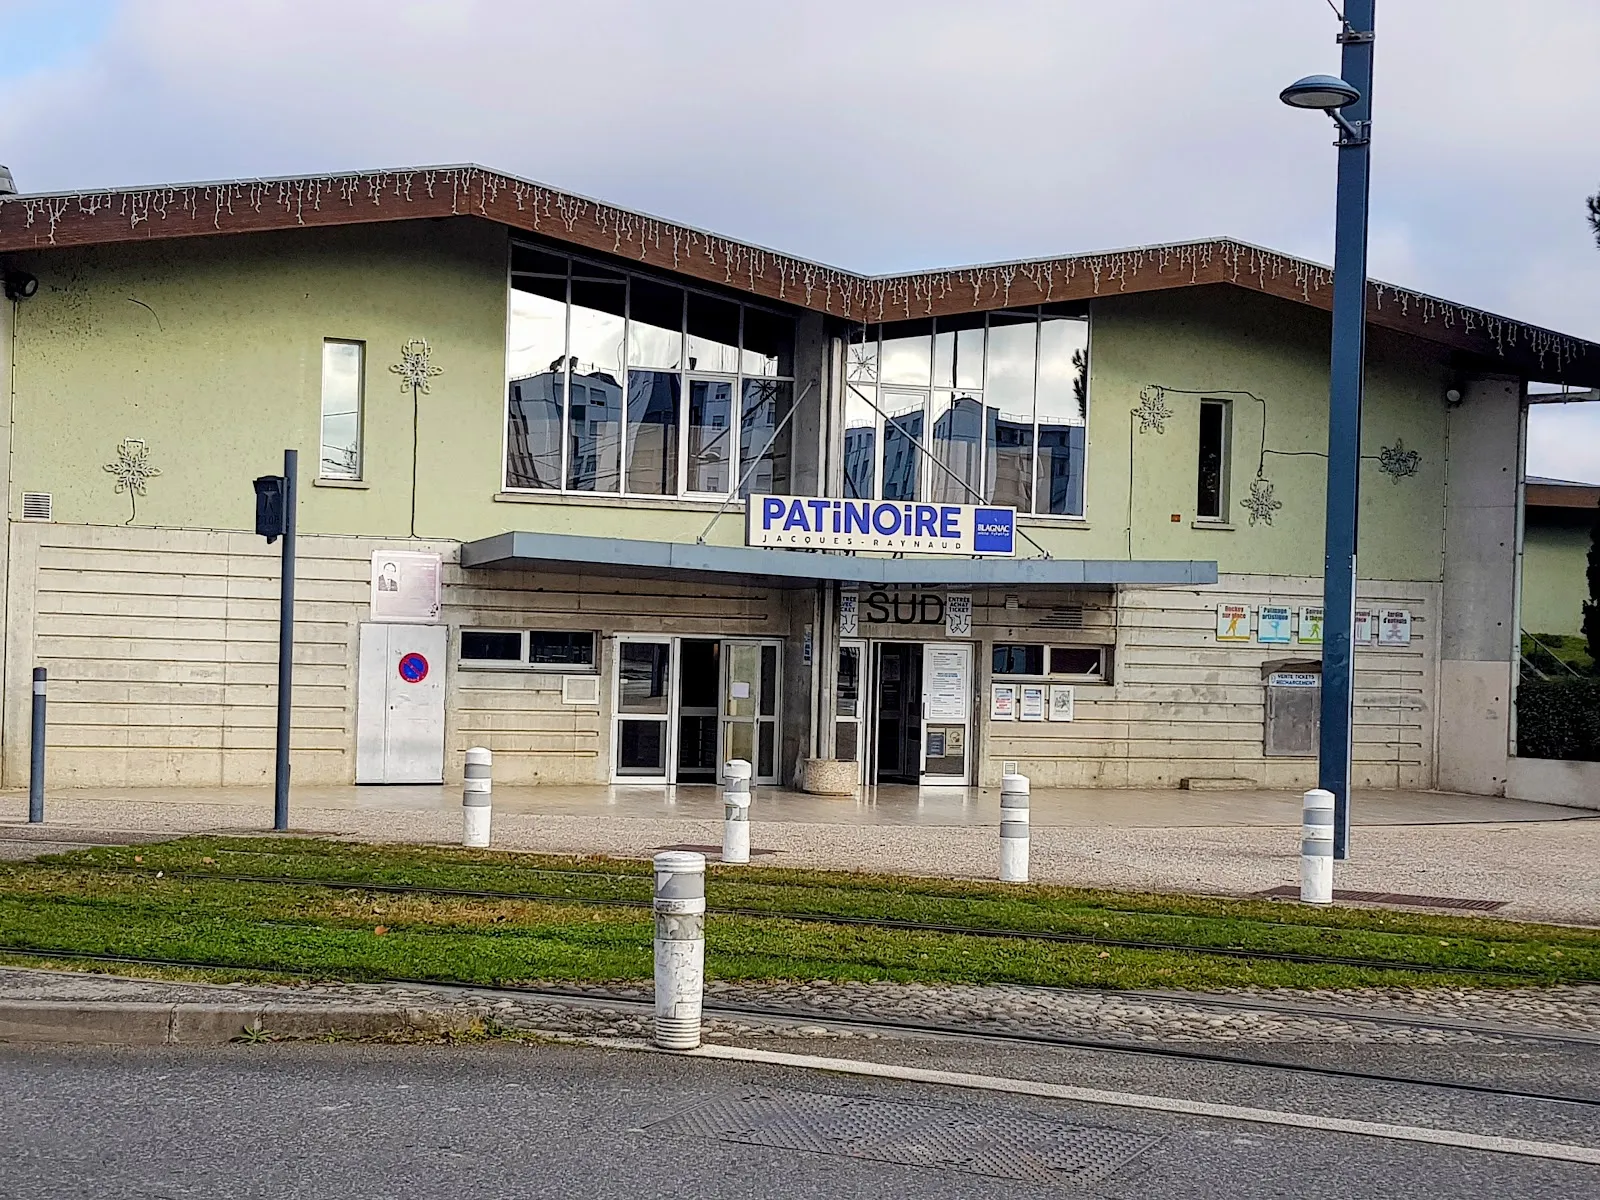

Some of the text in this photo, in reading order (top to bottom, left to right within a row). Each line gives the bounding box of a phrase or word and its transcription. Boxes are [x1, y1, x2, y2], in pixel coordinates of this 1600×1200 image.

[977, 523, 1011, 533] BLAGNAC
[866, 591, 944, 625] SUD
[1262, 613, 1289, 621] artistique
